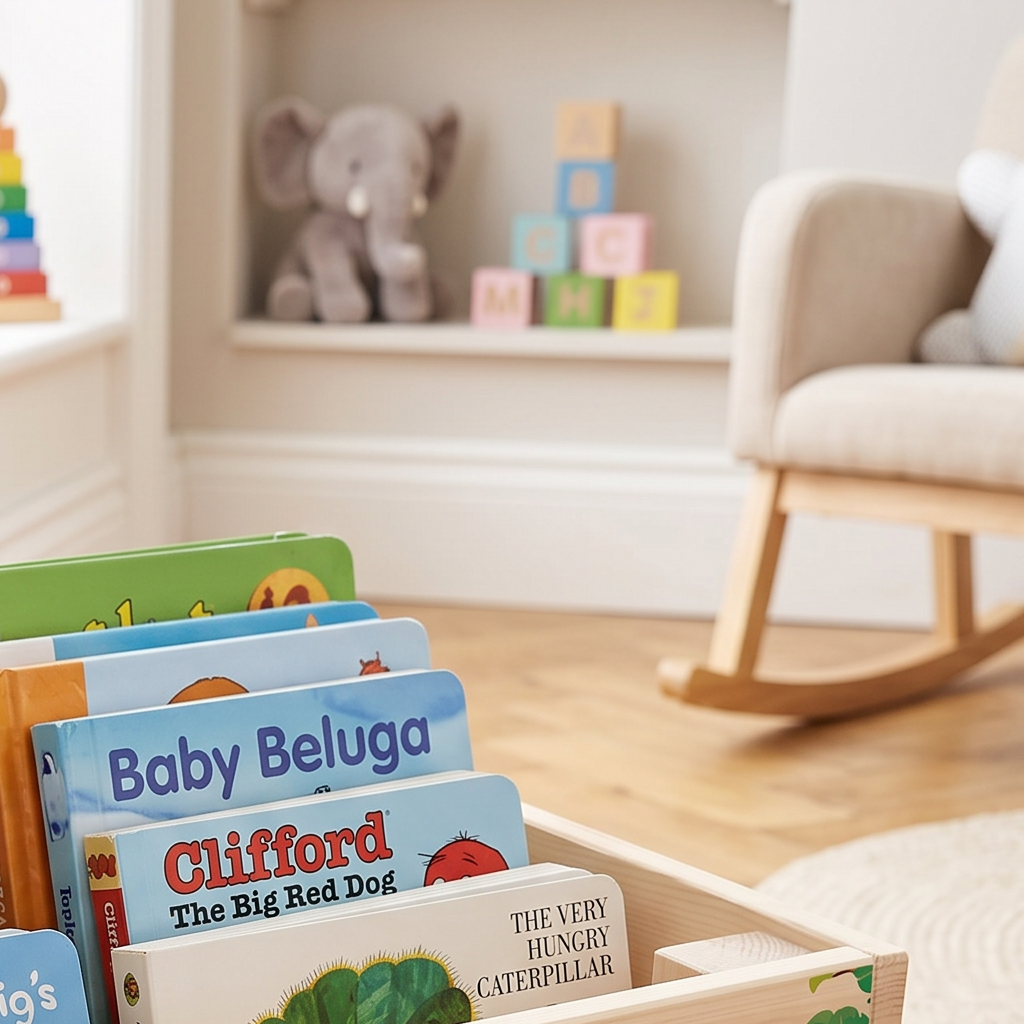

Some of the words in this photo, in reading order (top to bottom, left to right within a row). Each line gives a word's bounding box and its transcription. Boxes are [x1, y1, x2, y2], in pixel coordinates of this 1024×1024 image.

[108, 735, 240, 802] Baby
[257, 715, 431, 778] Beluga
[164, 810, 393, 894] Clifford
[170, 902, 226, 929] The
[231, 890, 280, 918] Big
[284, 878, 339, 909] Red
[343, 870, 397, 896] Dog
[510, 907, 552, 934] THE
[556, 897, 608, 925] VERY
[527, 925, 610, 960] HUNGRY
[477, 954, 615, 998] CATERPILLAR
